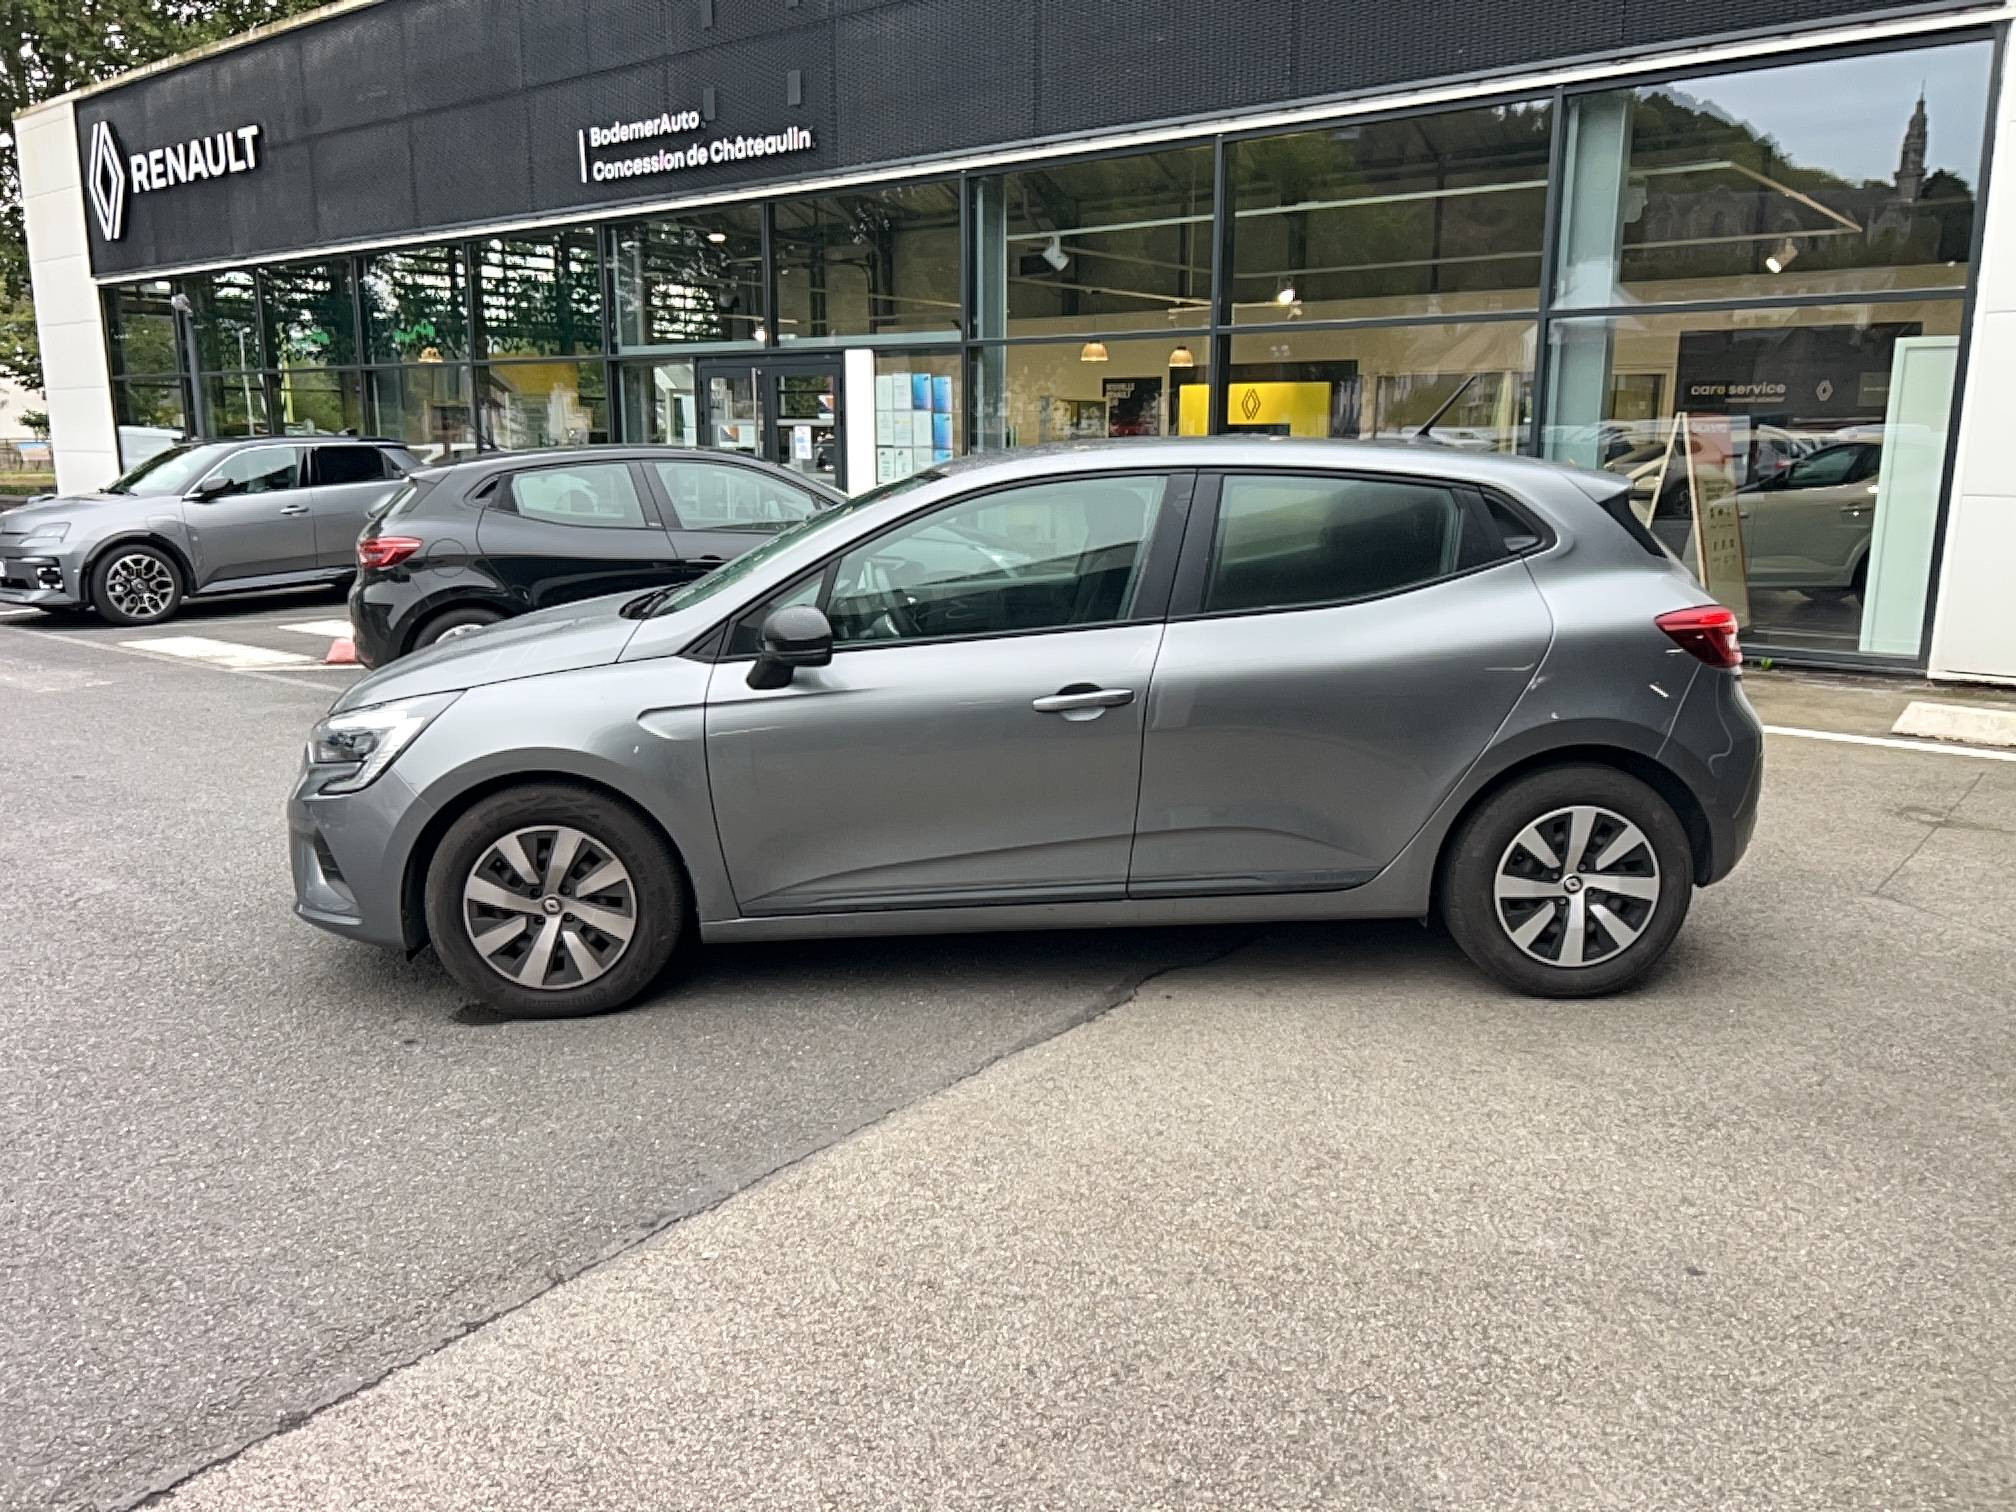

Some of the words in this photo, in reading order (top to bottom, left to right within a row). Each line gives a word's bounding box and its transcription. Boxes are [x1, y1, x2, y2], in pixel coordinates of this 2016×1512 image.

[589, 110, 700, 148] BodemerAuto
[130, 124, 258, 194] RENAULT
[592, 149, 685, 181] Concession
[686, 142, 709, 167] de
[709, 126, 812, 163] Châteaulin
[1728, 381, 1786, 396] service
